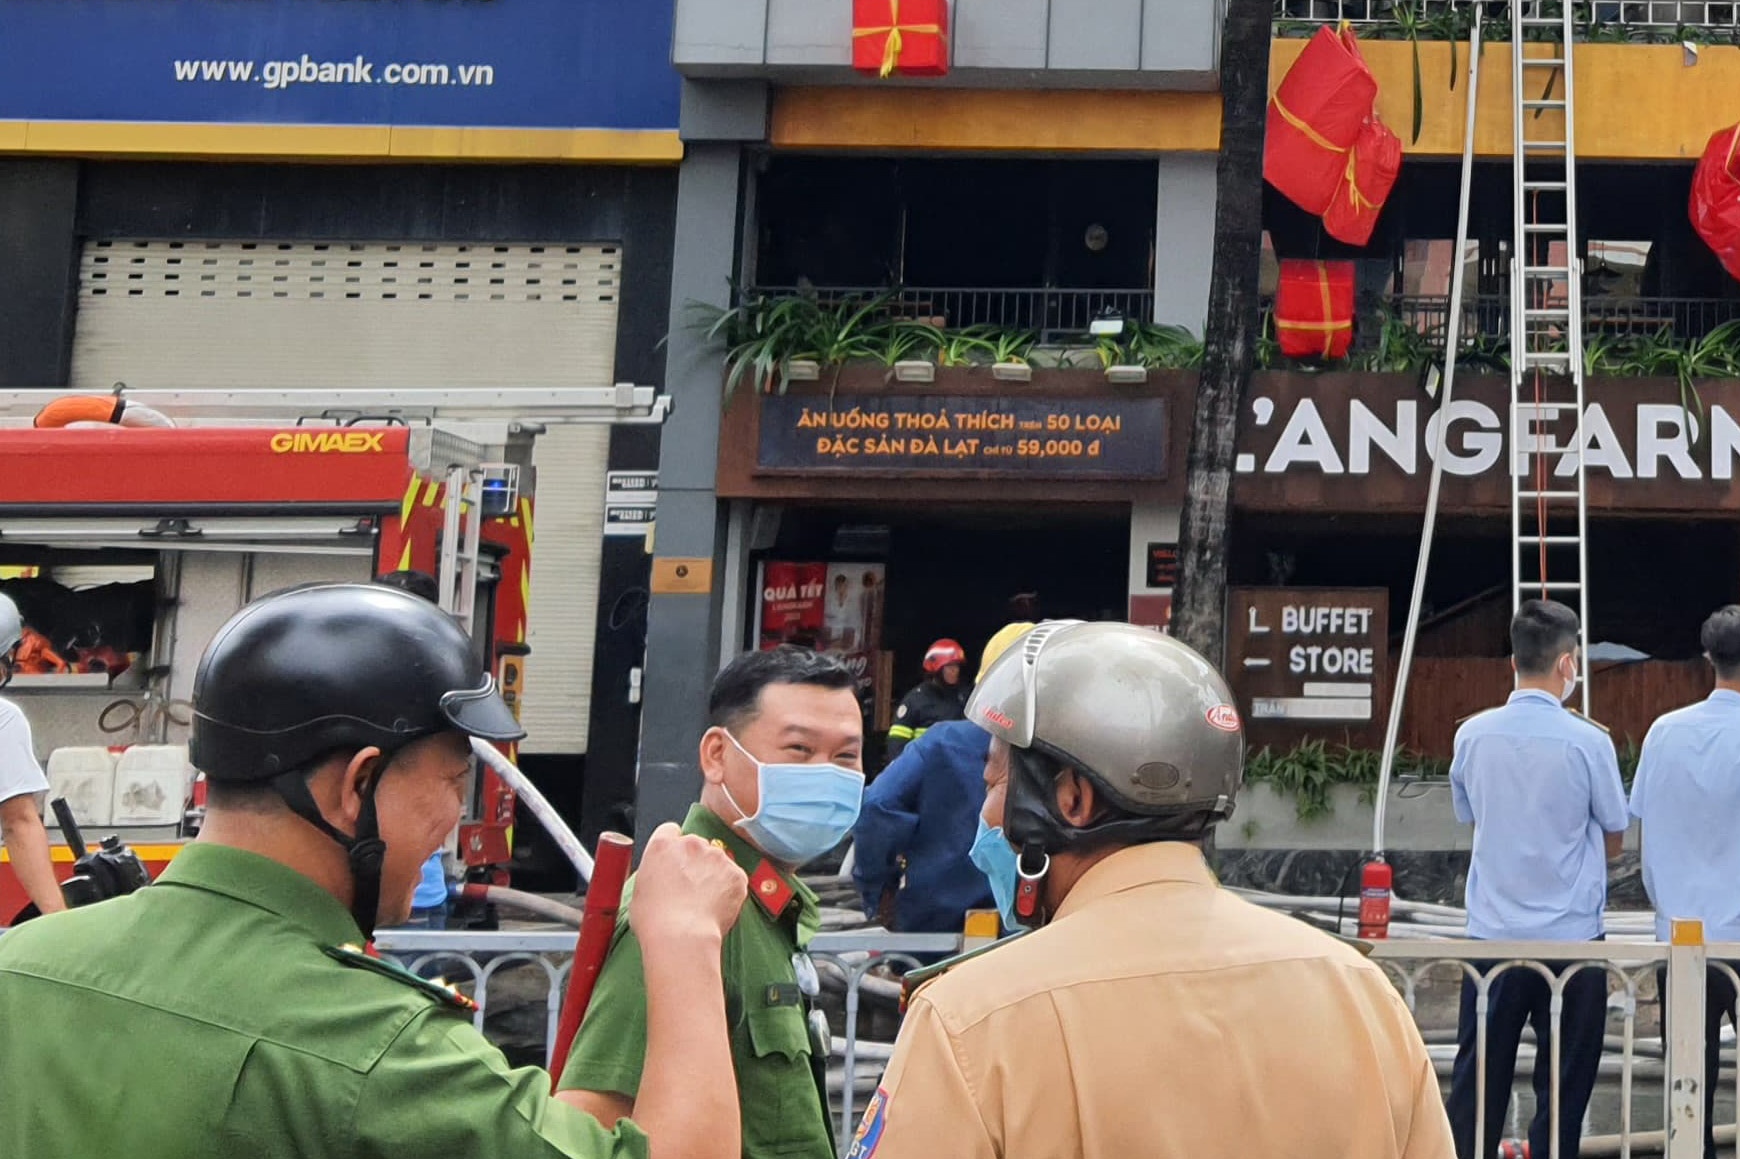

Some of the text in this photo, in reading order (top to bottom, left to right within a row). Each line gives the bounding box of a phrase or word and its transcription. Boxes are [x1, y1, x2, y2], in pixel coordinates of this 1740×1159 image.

[174, 53, 494, 89] www.gpbank.com.vn
[797, 407, 827, 428] ĂN
[832, 406, 891, 429] UỐNG
[955, 409, 1015, 430] THÍCH
[1047, 413, 1070, 431] 50
[1075, 413, 1121, 435] LOẠI
[270, 432, 385, 454] GIMAEX
[816, 433, 859, 459] ĐẶC
[910, 434, 938, 455] ĐÀ
[943, 437, 980, 459] LẠT
[1017, 438, 1083, 458] 59,000
[1281, 604, 1374, 634] BUFFET
[1289, 645, 1374, 675] STORE
